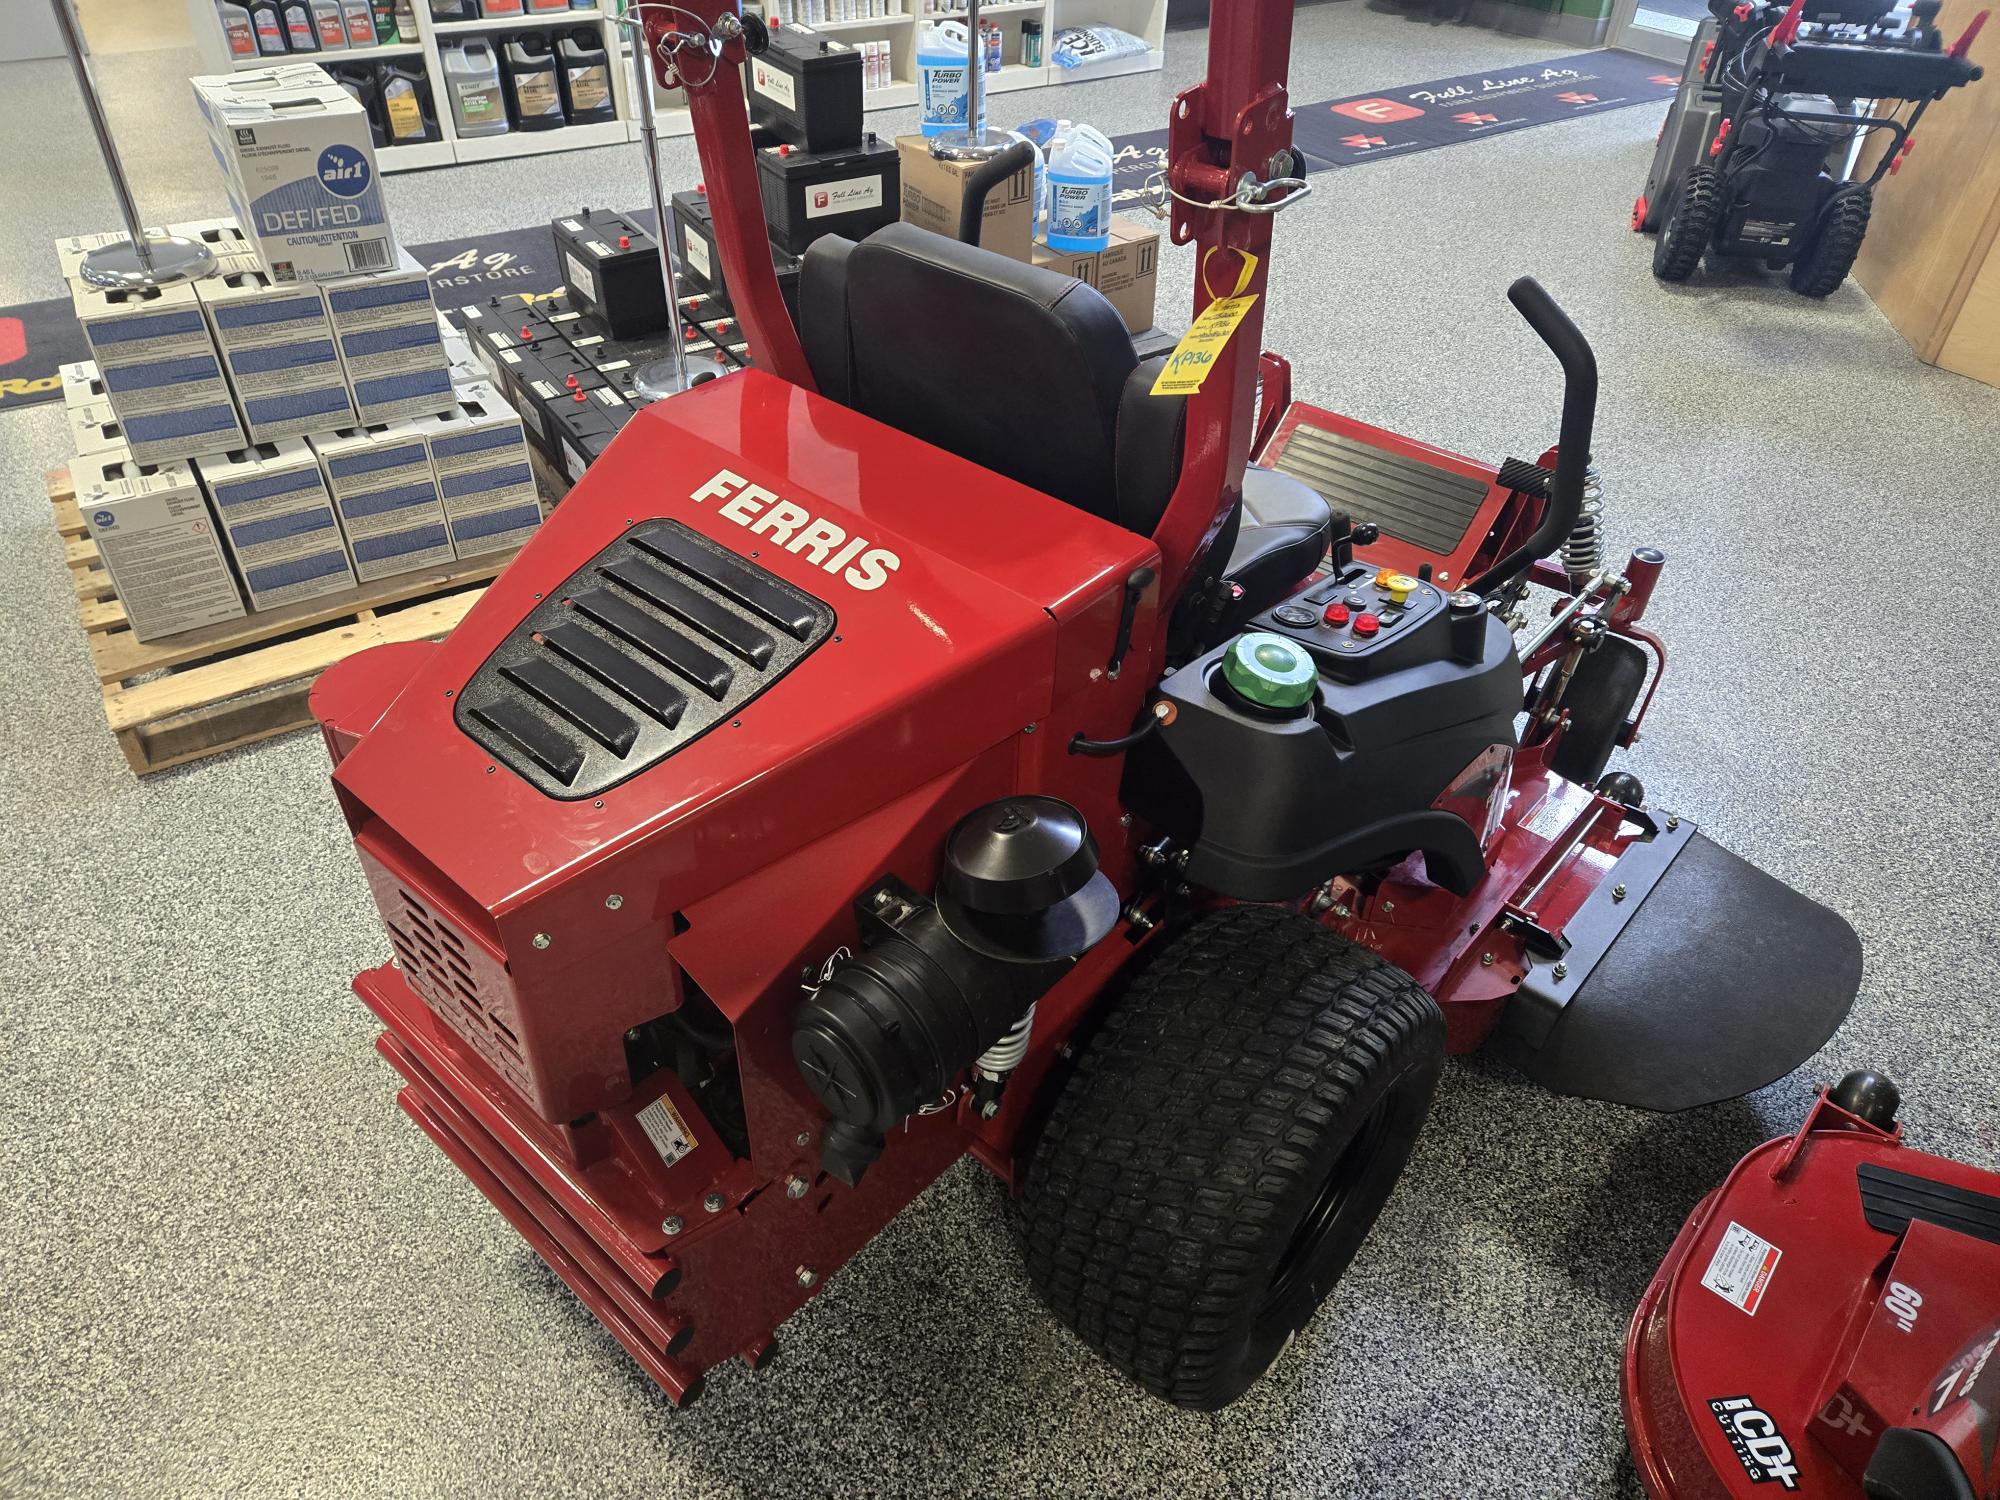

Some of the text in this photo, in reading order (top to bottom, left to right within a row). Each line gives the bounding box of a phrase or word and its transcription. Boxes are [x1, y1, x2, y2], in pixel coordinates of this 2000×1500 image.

[1063, 34, 1095, 56] ICE
[933, 70, 963, 78] TURBO
[1409, 68, 1580, 104] Full Line Ag
[832, 191, 847, 200] Full
[847, 187, 863, 197] Line
[863, 186, 873, 194] Ag
[1060, 186, 1090, 195] TURBO
[262, 204, 362, 232] DEF/FED
[286, 230, 359, 246] CAUTION/ATTENTION
[428, 248, 518, 277] Ag
[431, 265, 536, 290] RSTORE
[689, 468, 901, 591] FERRIS
[1752, 1270, 1768, 1292] DANGER
[1884, 1281, 1923, 1334] 60"
[1711, 1401, 1761, 1480] CUTTING
